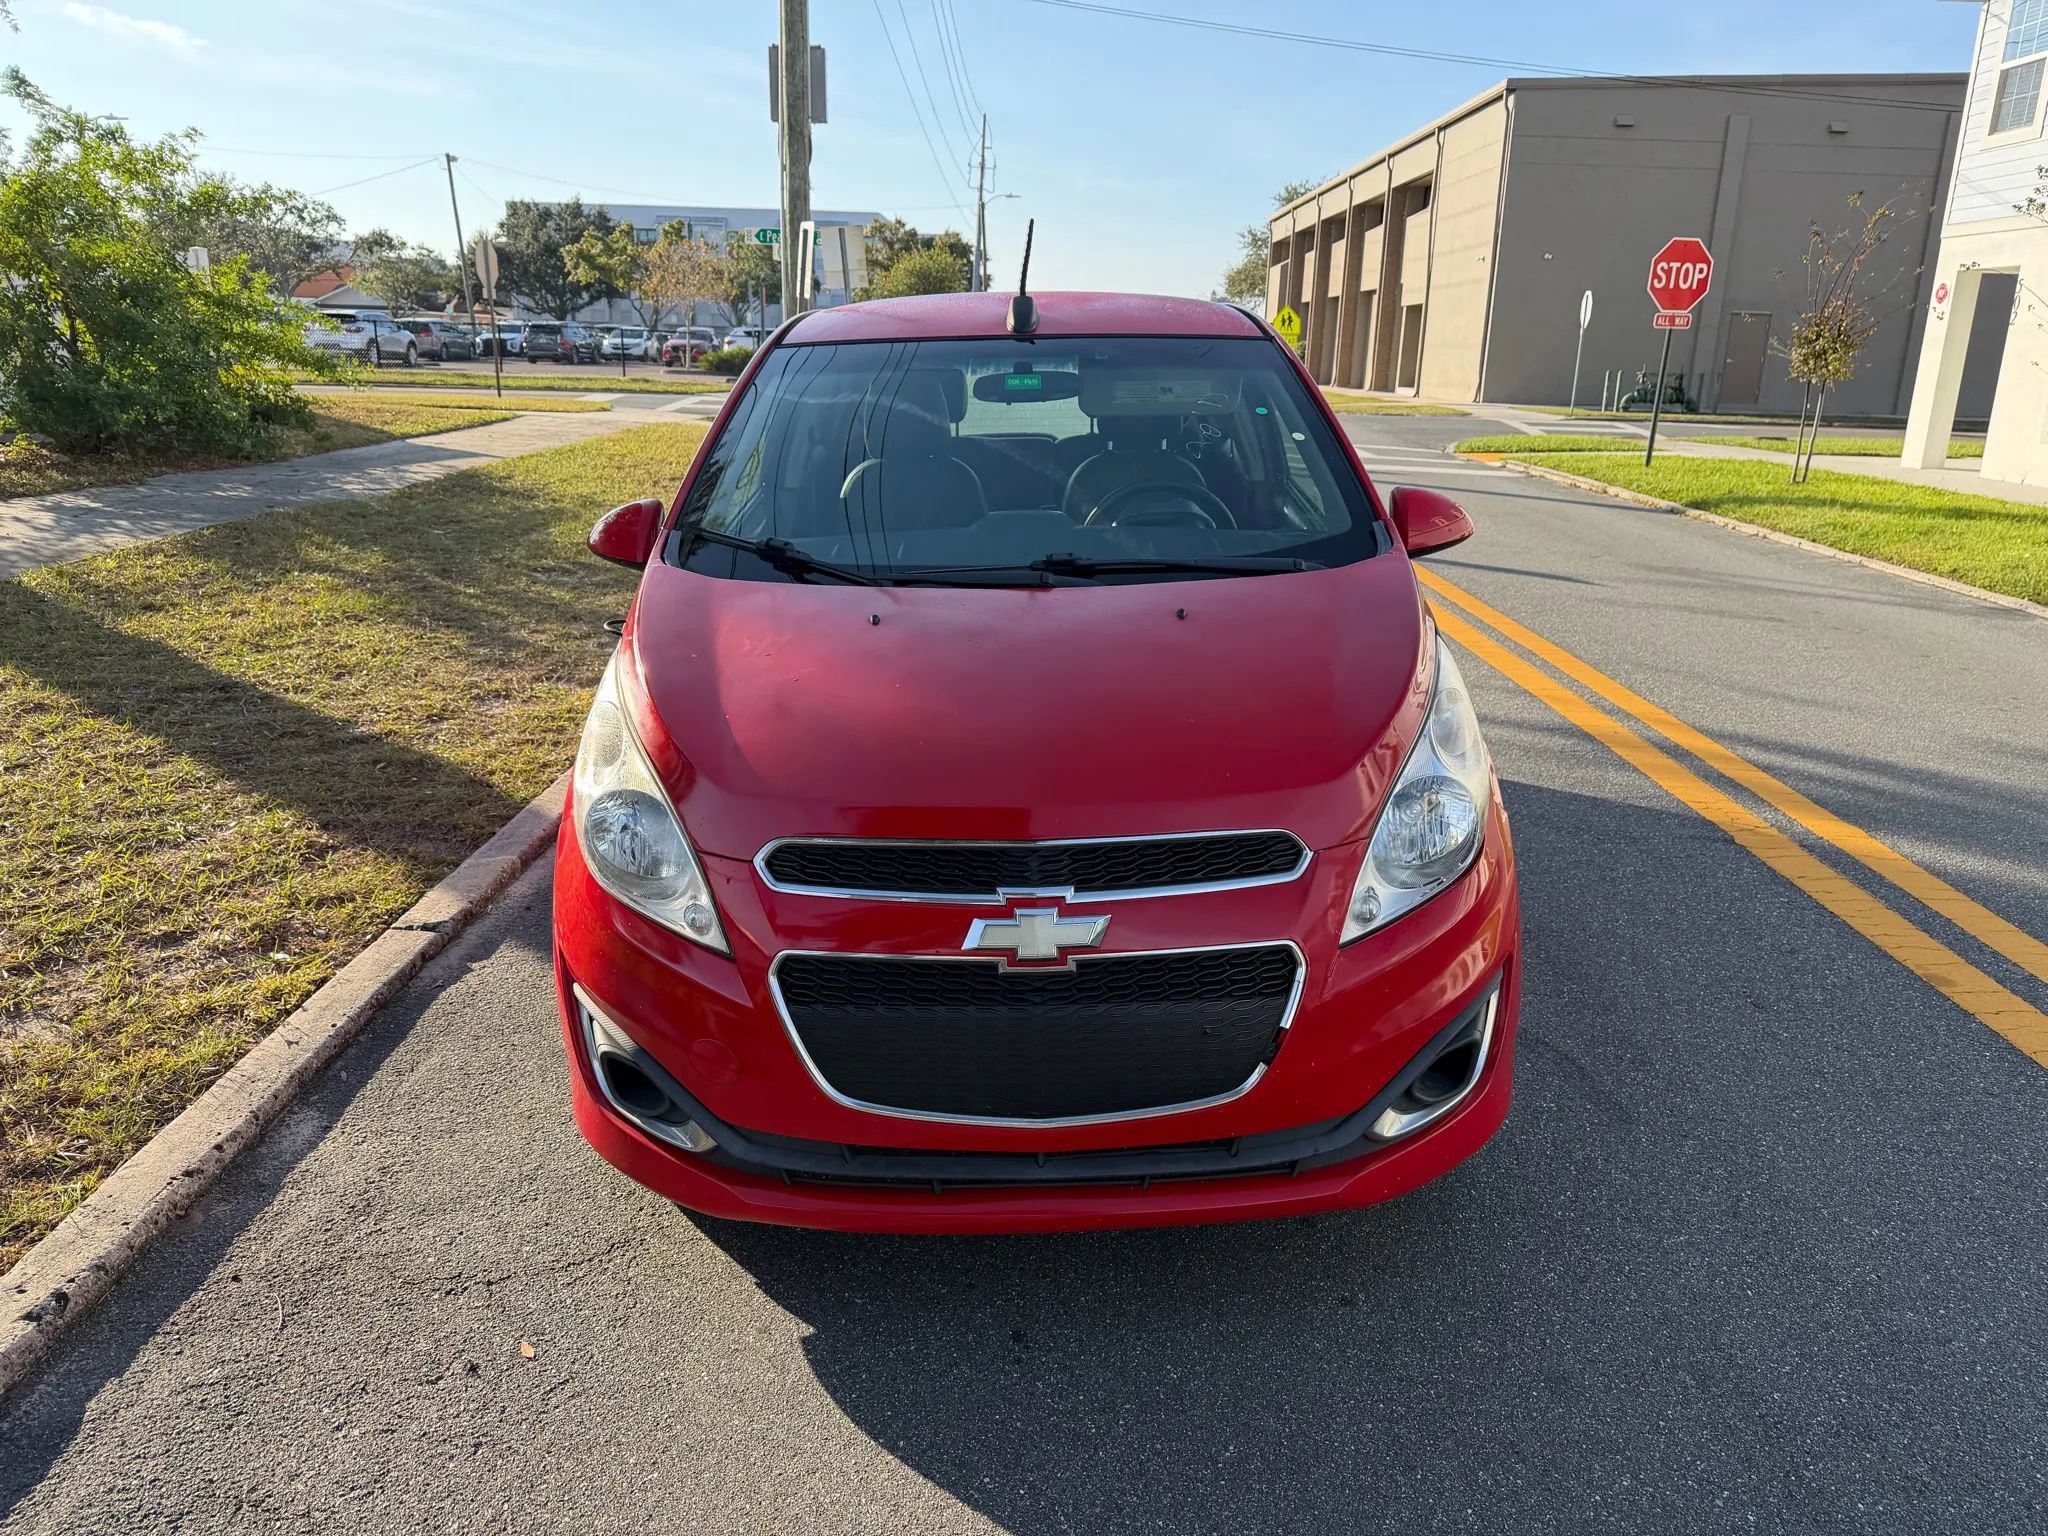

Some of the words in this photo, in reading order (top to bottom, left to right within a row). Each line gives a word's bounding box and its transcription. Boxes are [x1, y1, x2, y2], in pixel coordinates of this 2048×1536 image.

[766, 230, 782, 244] Pea
[1653, 261, 1708, 290] STOP
[1657, 316, 1670, 326] ALL
[1674, 316, 1689, 326] WAY
